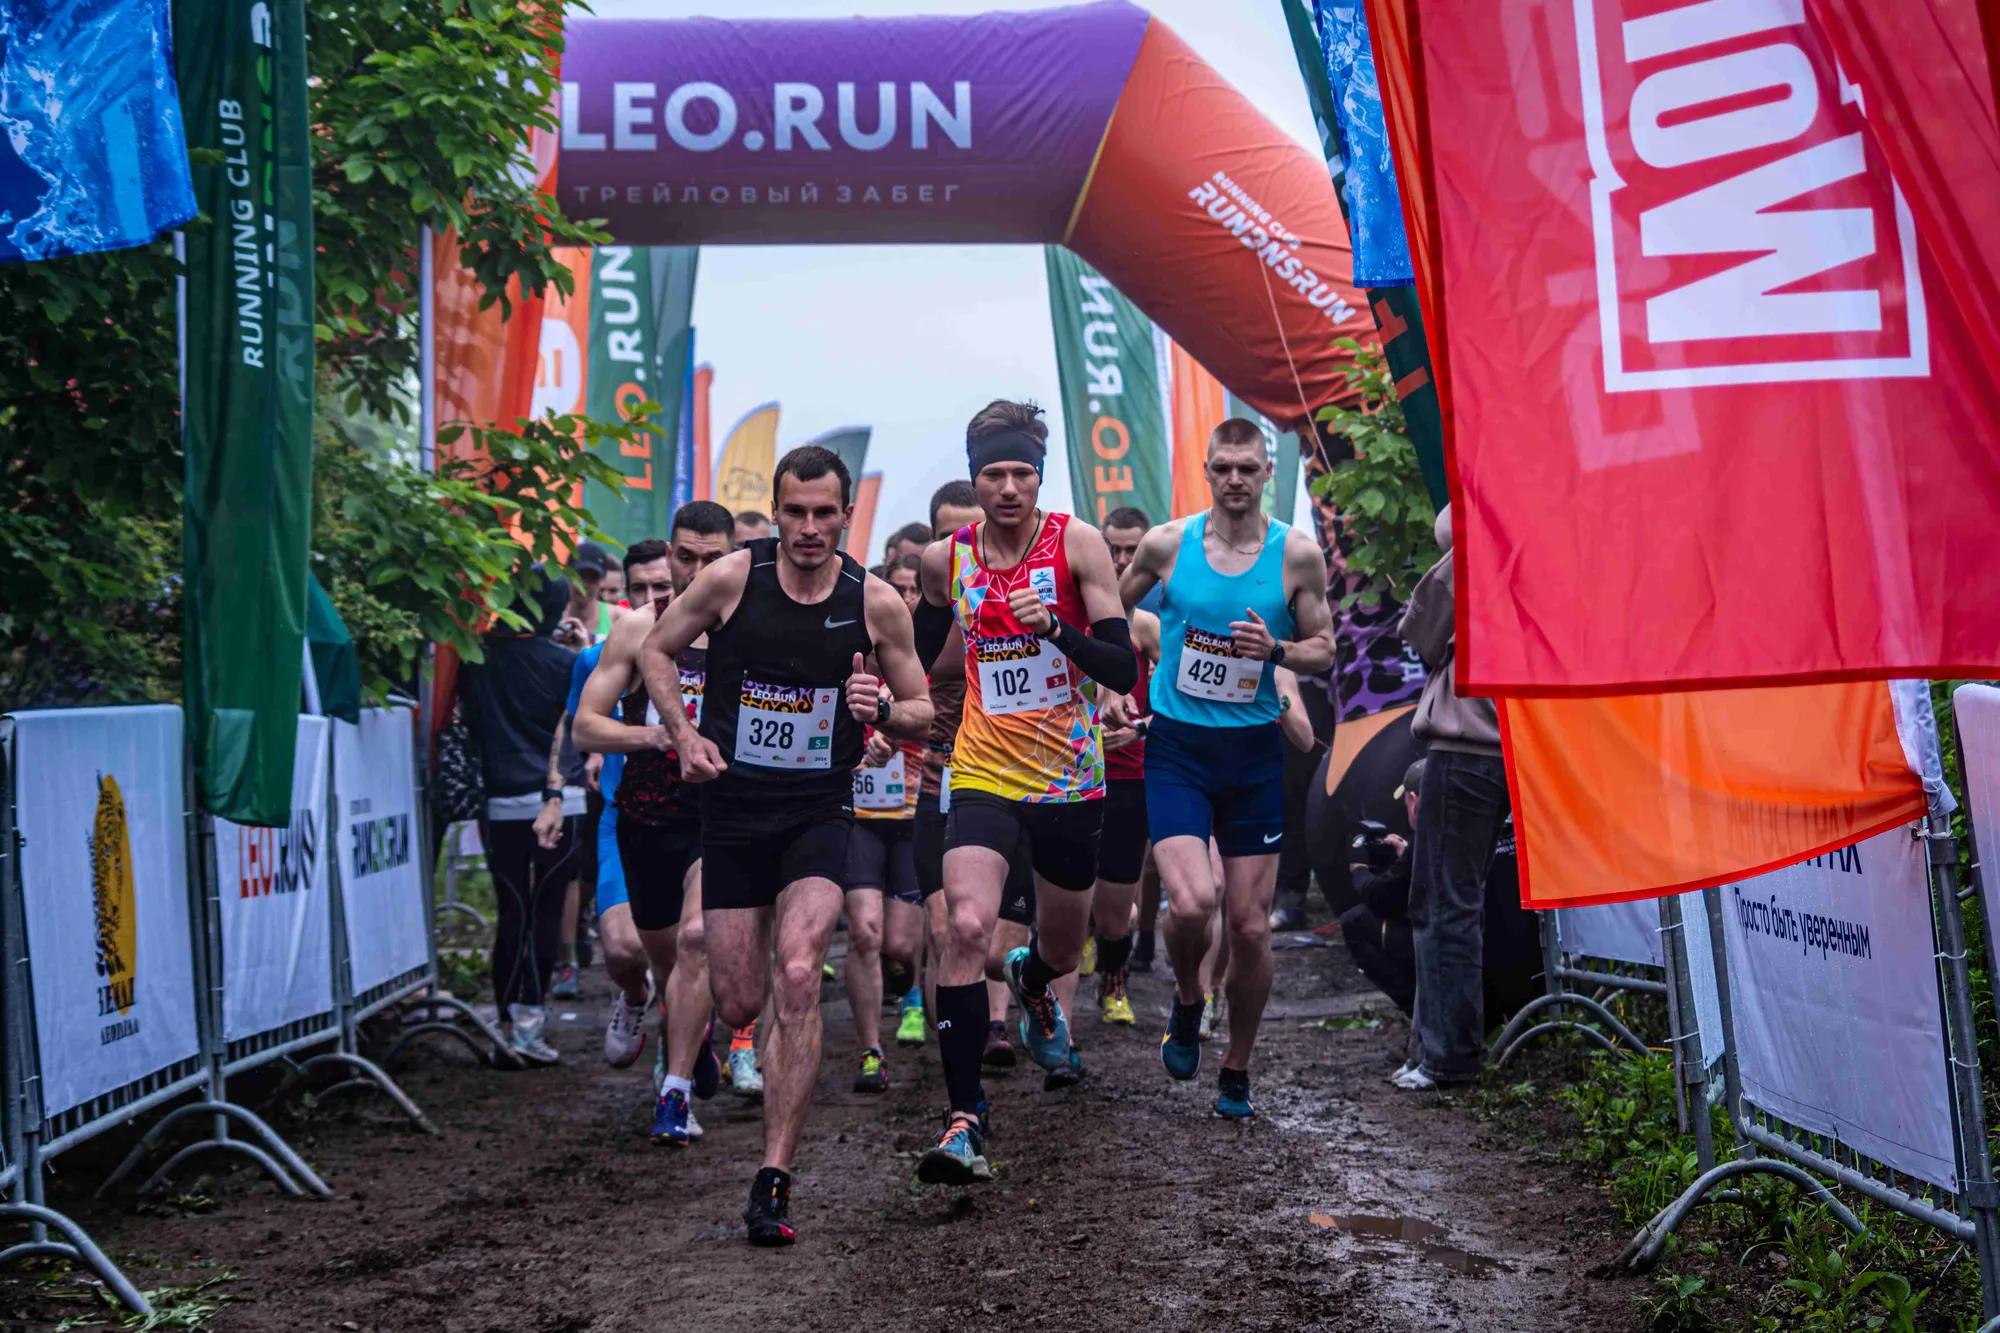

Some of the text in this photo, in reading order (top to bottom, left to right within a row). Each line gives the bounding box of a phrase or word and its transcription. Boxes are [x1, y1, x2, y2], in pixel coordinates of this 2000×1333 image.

[561, 81, 972, 151] LEO.RUN
[574, 182, 960, 202] ТРЕЙЛОВЫЙ ЗАБЕГ
[1212, 170, 1273, 225] RUNNING
[219, 98, 264, 369] RUNNING CLUB
[598, 246, 653, 491] LEO.RUN
[983, 640, 1023, 653] LEO.RUN
[992, 668, 1031, 697] 102
[1188, 659, 1227, 686] 429
[751, 689, 797, 702] LEO.RUN
[749, 718, 794, 750] 328
[854, 774, 874, 795] 56
[1734, 887, 1872, 961] Просто быть уверенным
